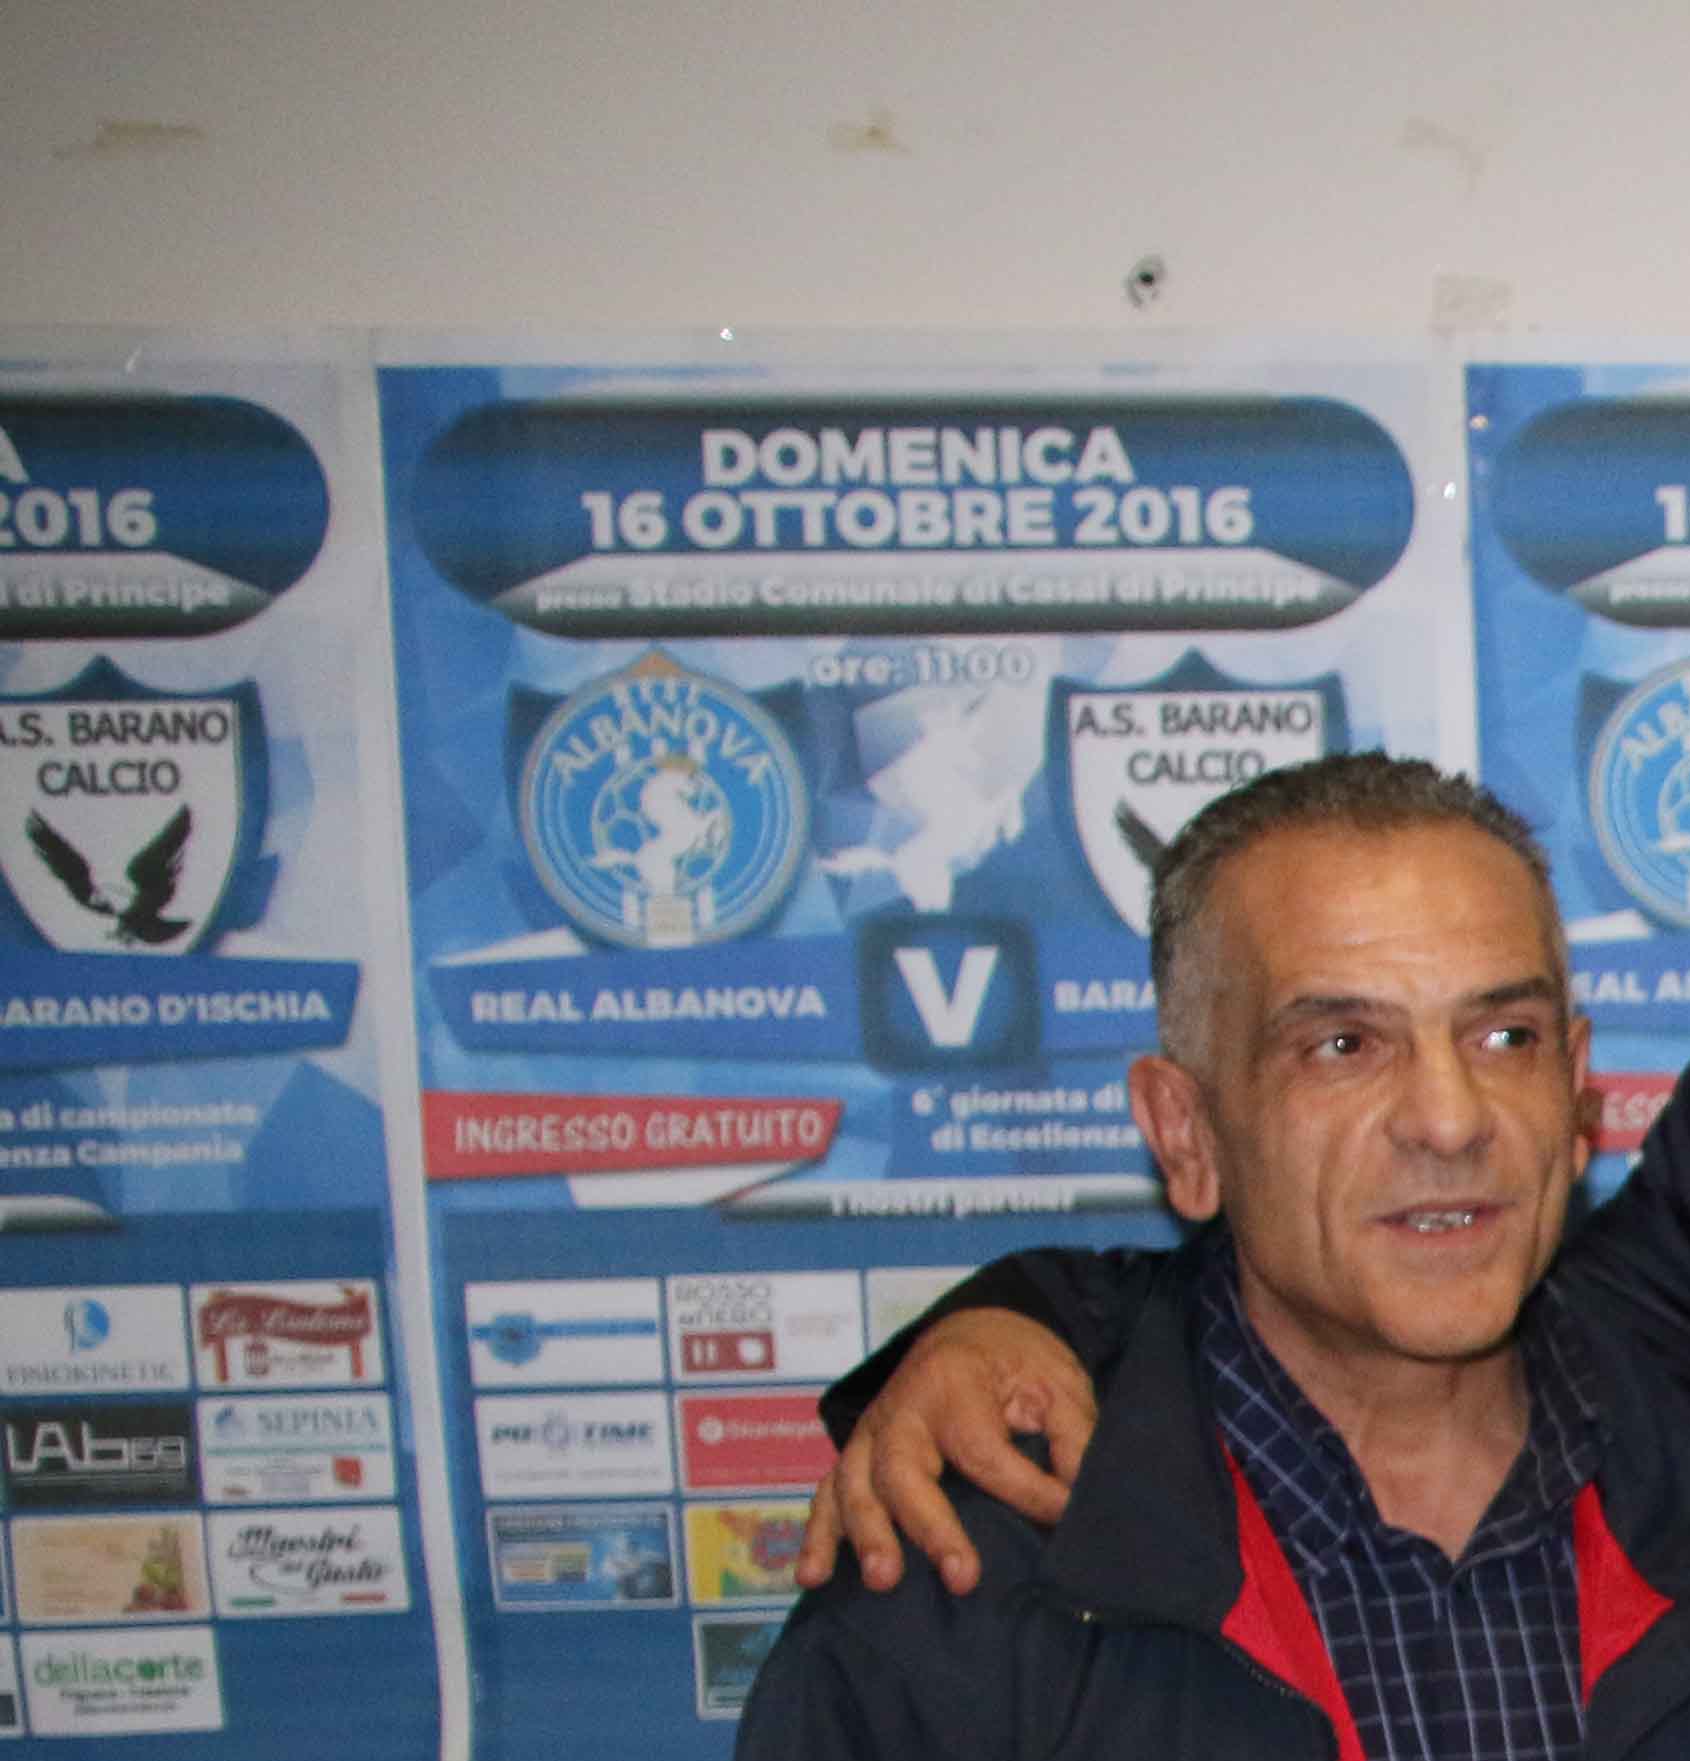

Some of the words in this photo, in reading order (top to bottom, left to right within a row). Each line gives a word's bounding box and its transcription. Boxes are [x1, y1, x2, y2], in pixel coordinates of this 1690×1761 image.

[701, 427, 1134, 488] DOMENICA
[582, 491, 666, 549] 16
[684, 489, 1055, 547] OTTOBRE
[1072, 486, 1254, 545] 2016
[68, 711, 229, 746] BARANO
[1075, 702, 1145, 736] A.S.
[1159, 701, 1312, 735] BARANO
[554, 703, 770, 786] ALBANOVA
[37, 759, 180, 797] CALCIO
[1127, 749, 1265, 784] CALCIO
[0, 995, 150, 1027] ARANO
[157, 989, 332, 1024] D'ISCHIA
[470, 991, 585, 1023] REAL
[590, 985, 827, 1022] ALBANOVA
[893, 945, 999, 1048] V
[1053, 979, 1157, 1012] BARA
[455, 1113, 635, 1153] INGRESSO
[645, 1108, 823, 1149] GRATUITO
